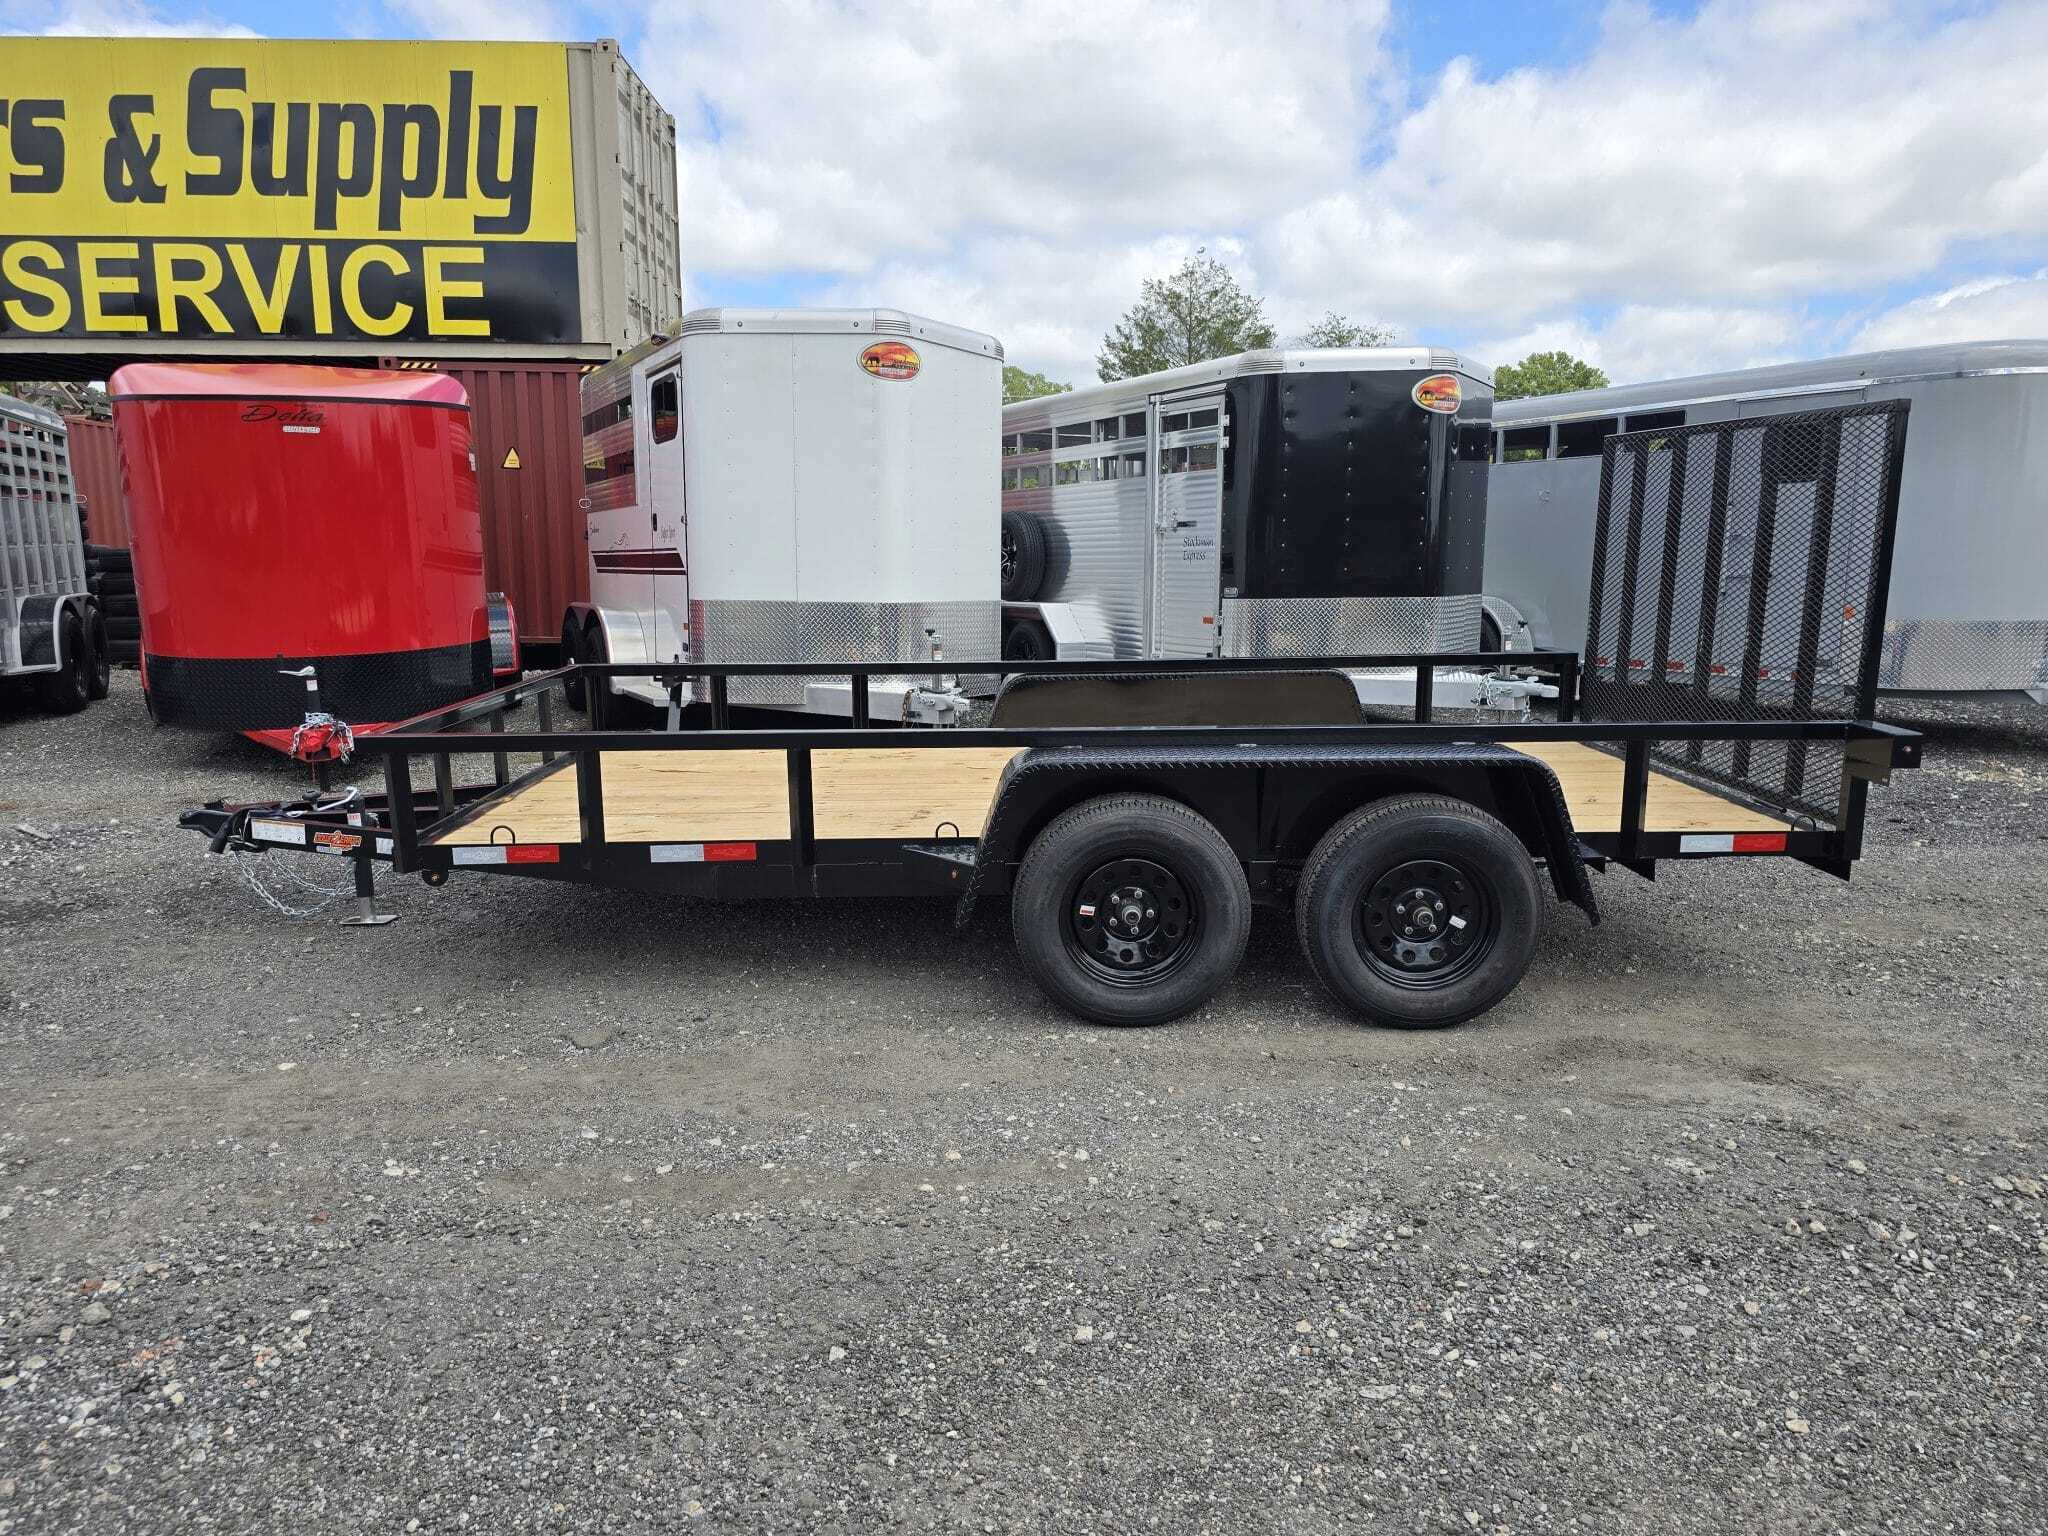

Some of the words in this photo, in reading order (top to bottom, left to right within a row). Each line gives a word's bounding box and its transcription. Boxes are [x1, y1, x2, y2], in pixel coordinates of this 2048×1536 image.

[103, 94, 167, 203] &
[185, 67, 537, 234] Supply
[1, 240, 490, 336] SERVICE
[240, 404, 323, 422] Delta
